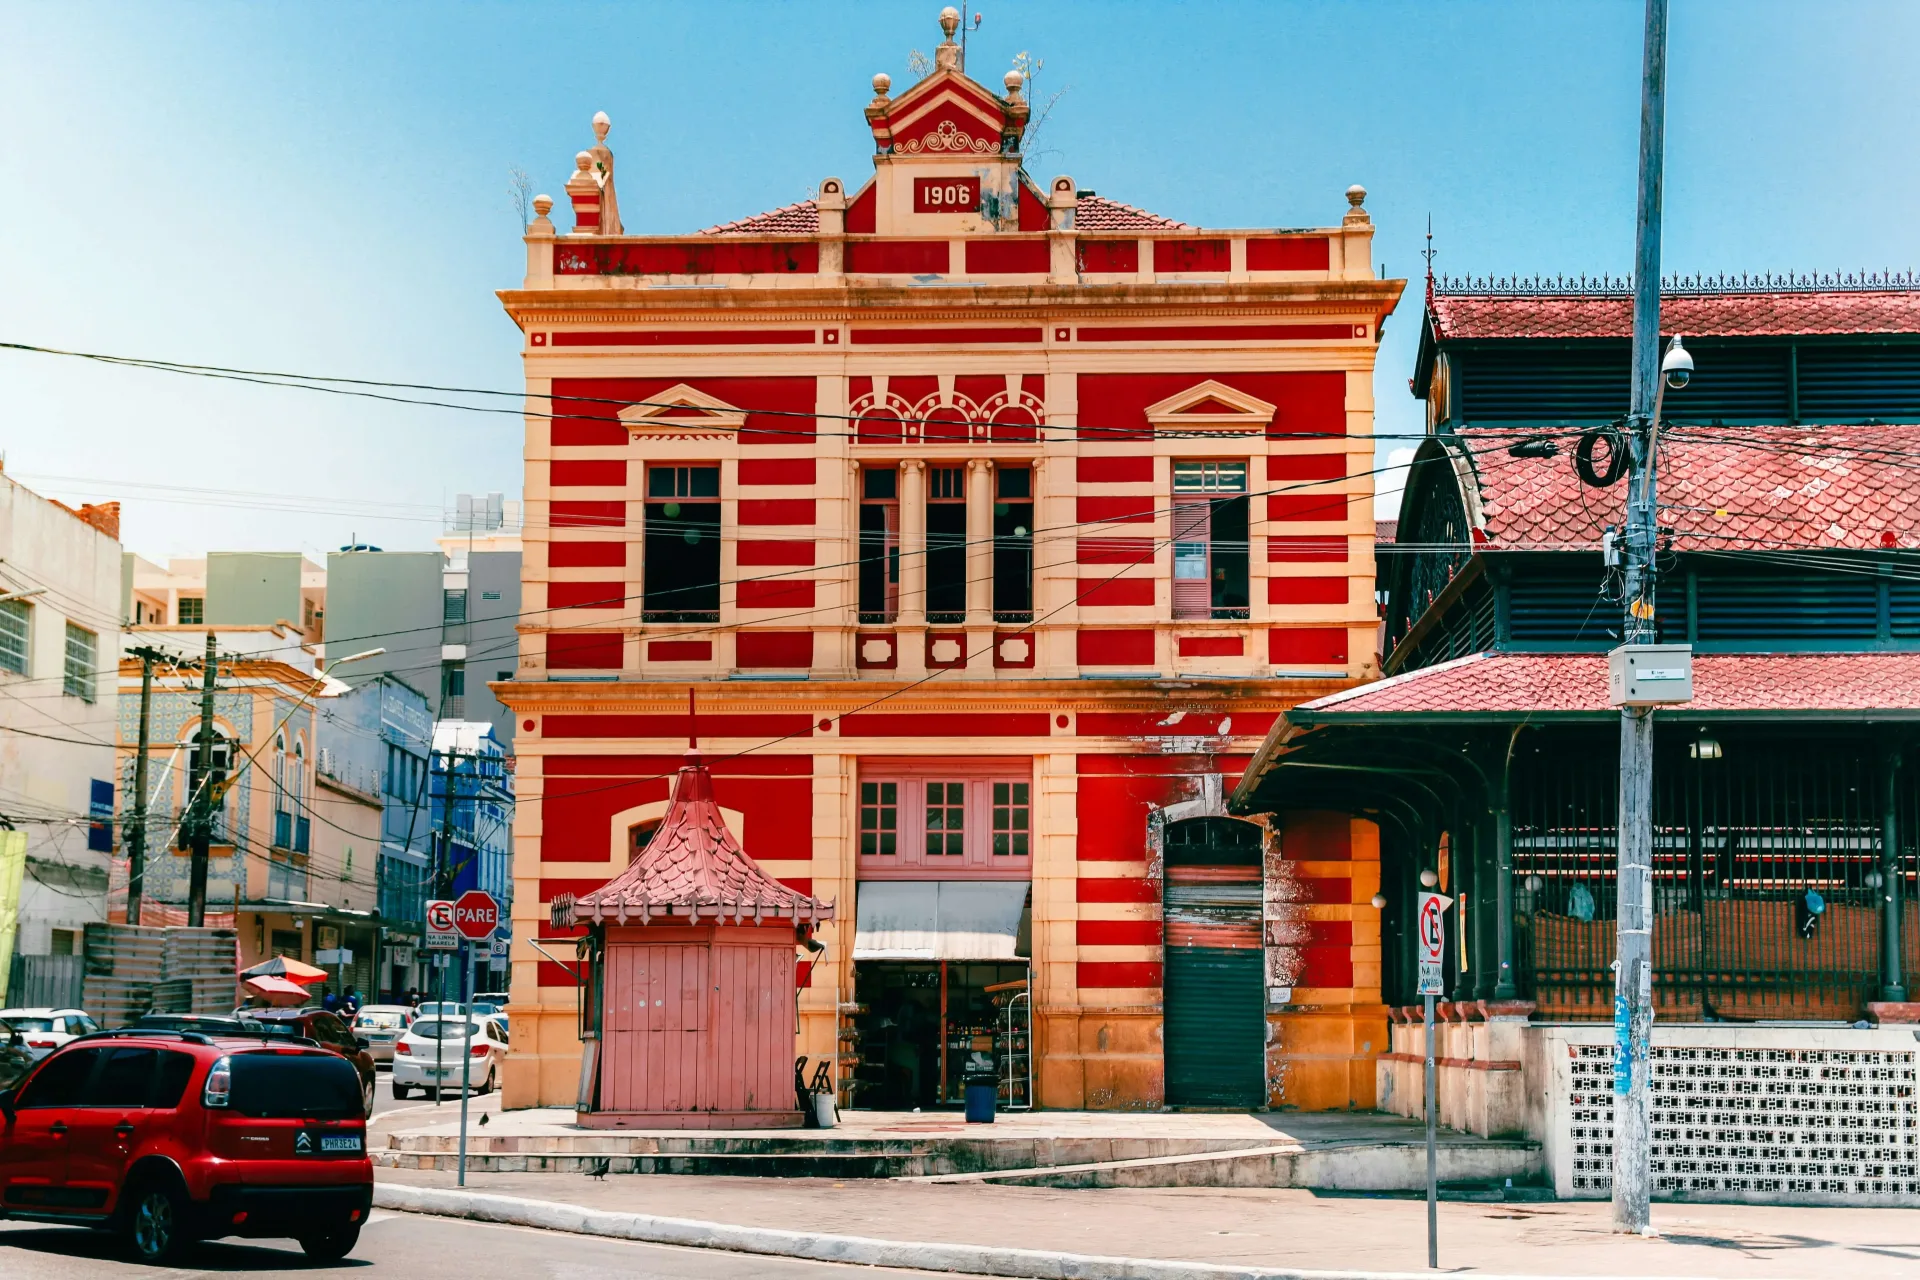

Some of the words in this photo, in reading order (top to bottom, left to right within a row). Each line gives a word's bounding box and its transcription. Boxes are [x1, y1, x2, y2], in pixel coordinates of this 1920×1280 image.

[924, 186, 970, 205] 1906
[456, 907, 495, 923] PARE
[325, 1139, 358, 1149] PHR3E24
